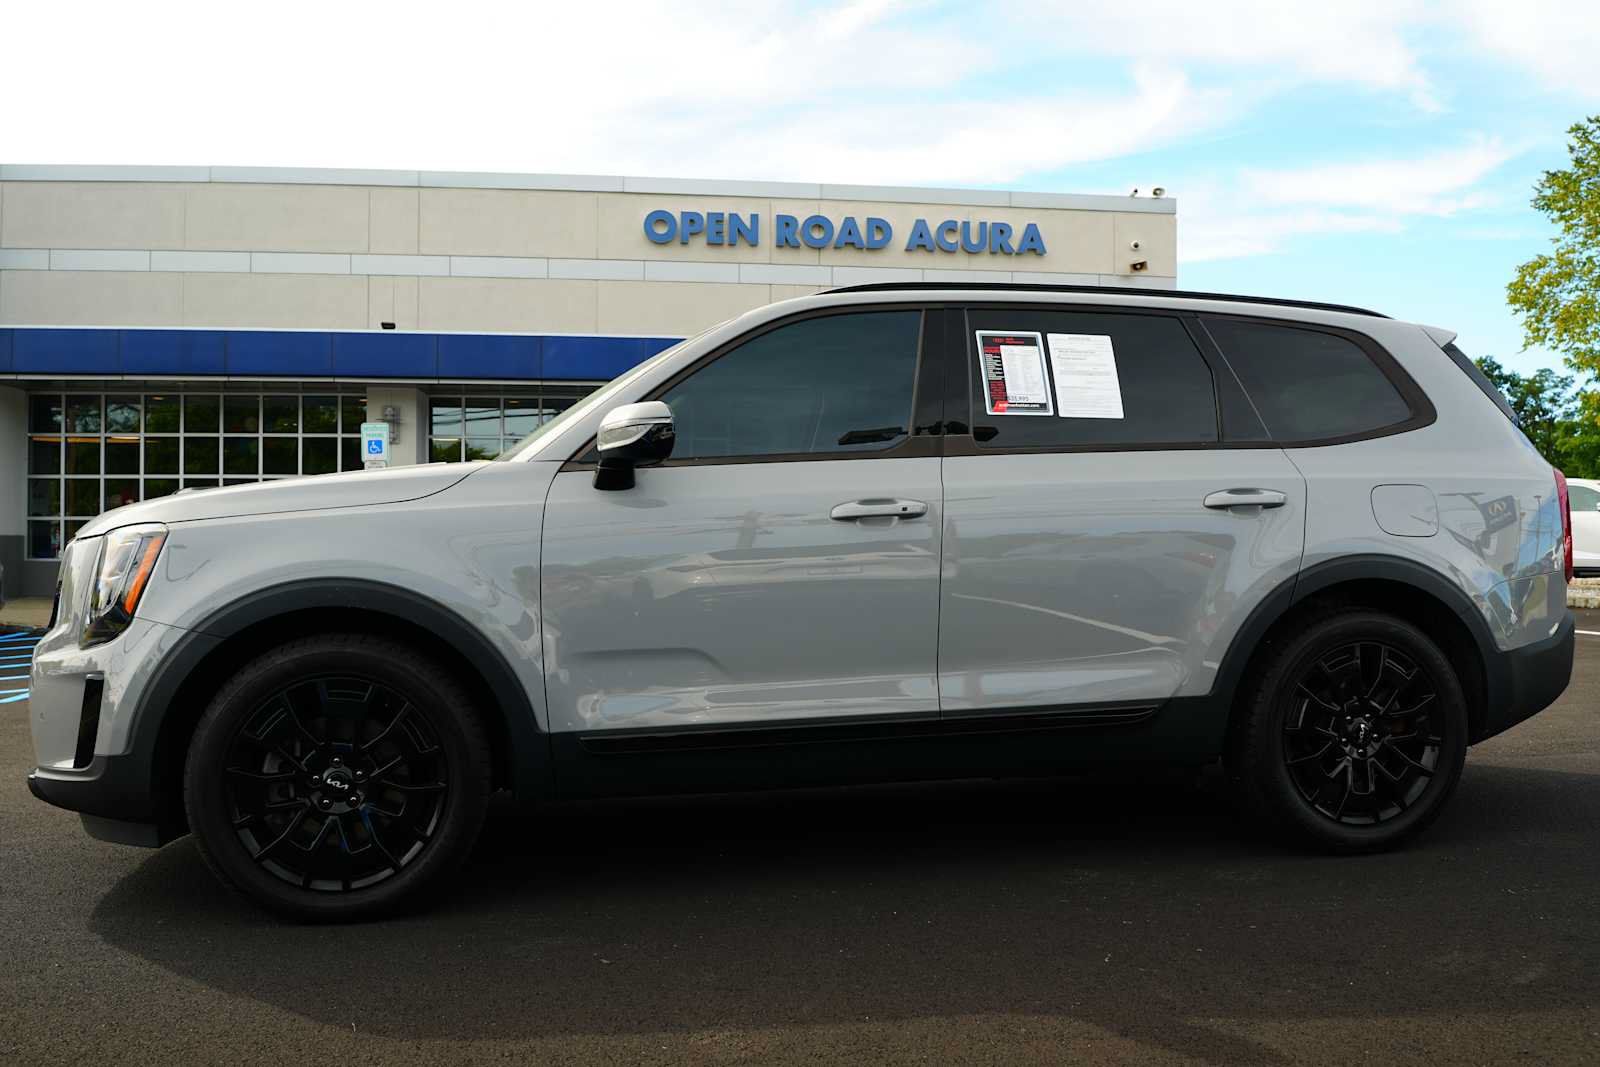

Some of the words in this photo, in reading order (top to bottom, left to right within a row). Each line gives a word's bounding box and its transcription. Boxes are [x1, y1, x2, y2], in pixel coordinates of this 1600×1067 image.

[643, 209, 760, 247] OPEN
[775, 213, 893, 251] ROAD
[905, 218, 1047, 256] ACURA
